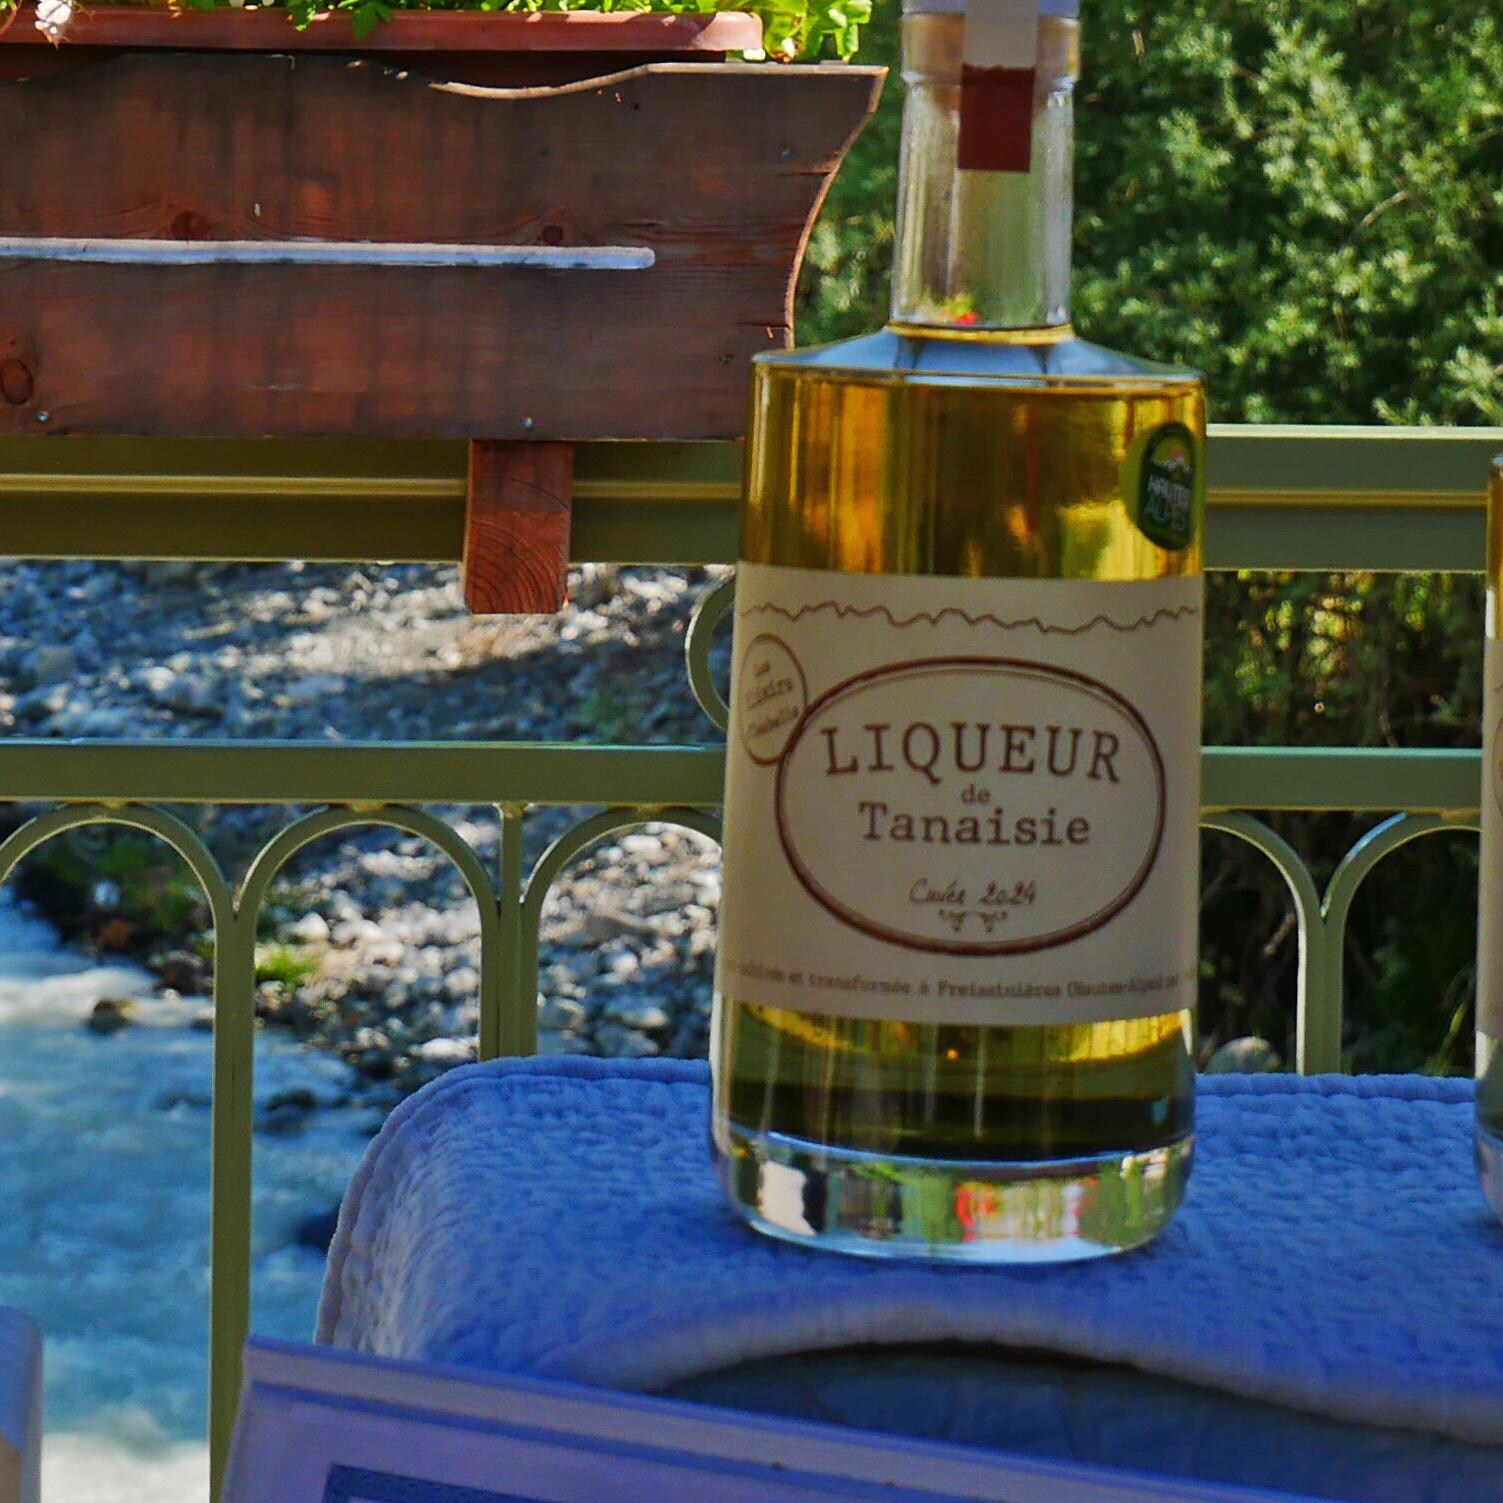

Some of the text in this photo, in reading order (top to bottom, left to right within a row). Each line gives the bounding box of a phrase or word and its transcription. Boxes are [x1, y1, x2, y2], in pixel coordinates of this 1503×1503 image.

[820, 721, 1121, 785] LIQUEUR
[961, 783, 991, 806] de
[858, 800, 1091, 846] Tanaisie
